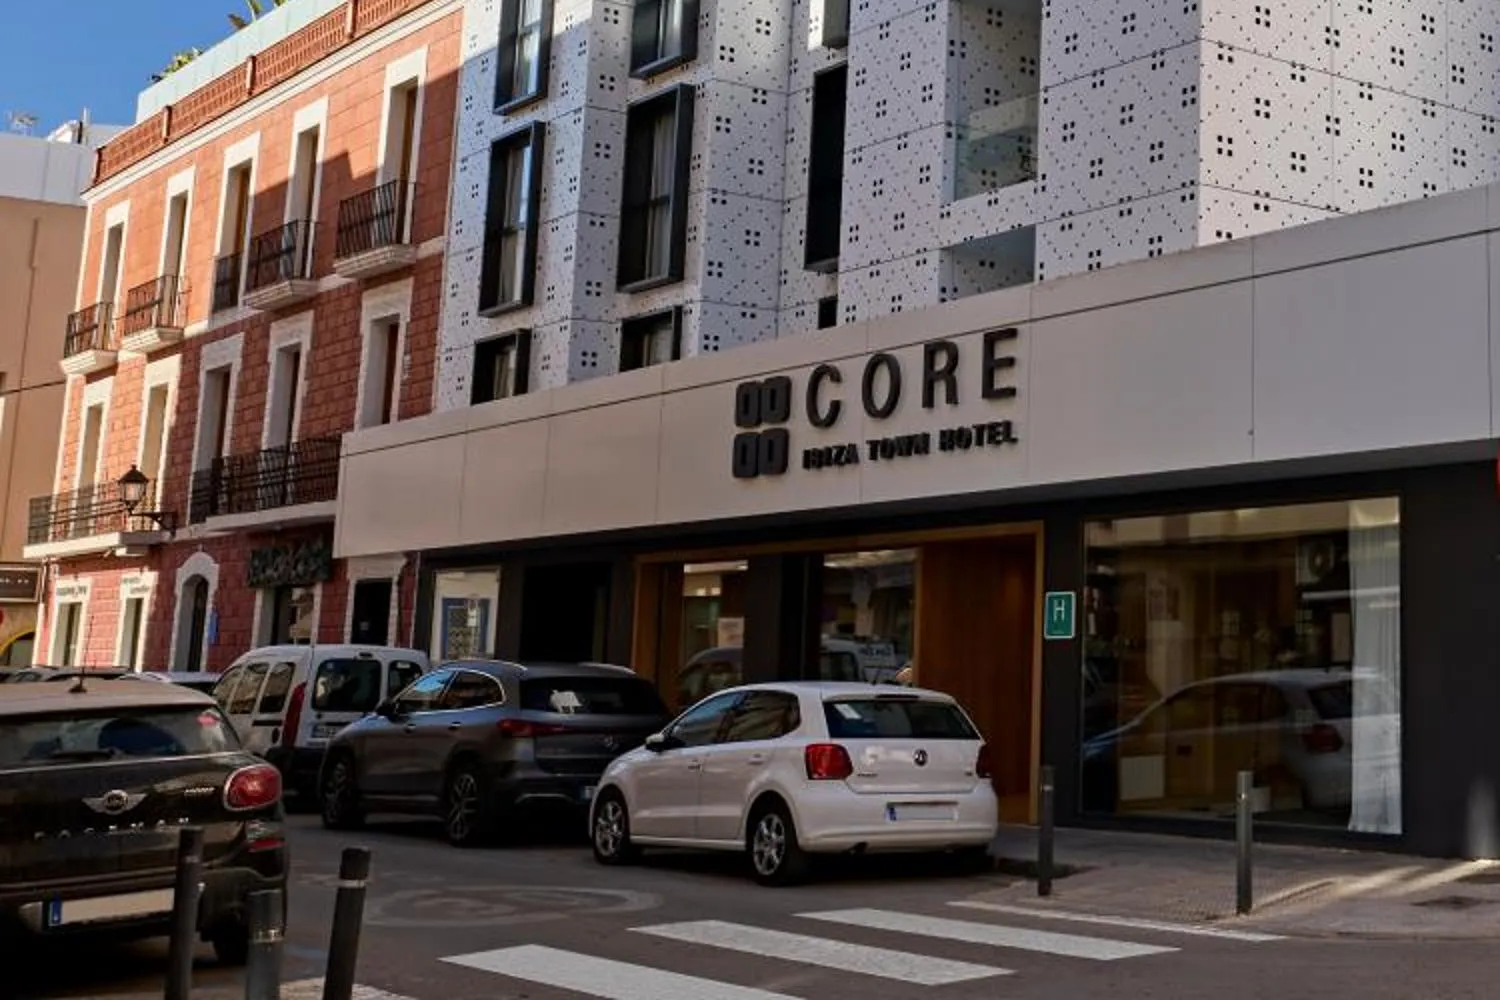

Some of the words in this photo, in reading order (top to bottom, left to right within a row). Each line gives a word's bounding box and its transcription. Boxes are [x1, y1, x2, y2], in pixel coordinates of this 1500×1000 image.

[806, 328, 1018, 428] CORE
[803, 444, 860, 470] IBIZA
[866, 433, 930, 461] TOWN
[939, 421, 1018, 452] HOTEL
[1053, 599, 1065, 621] H
